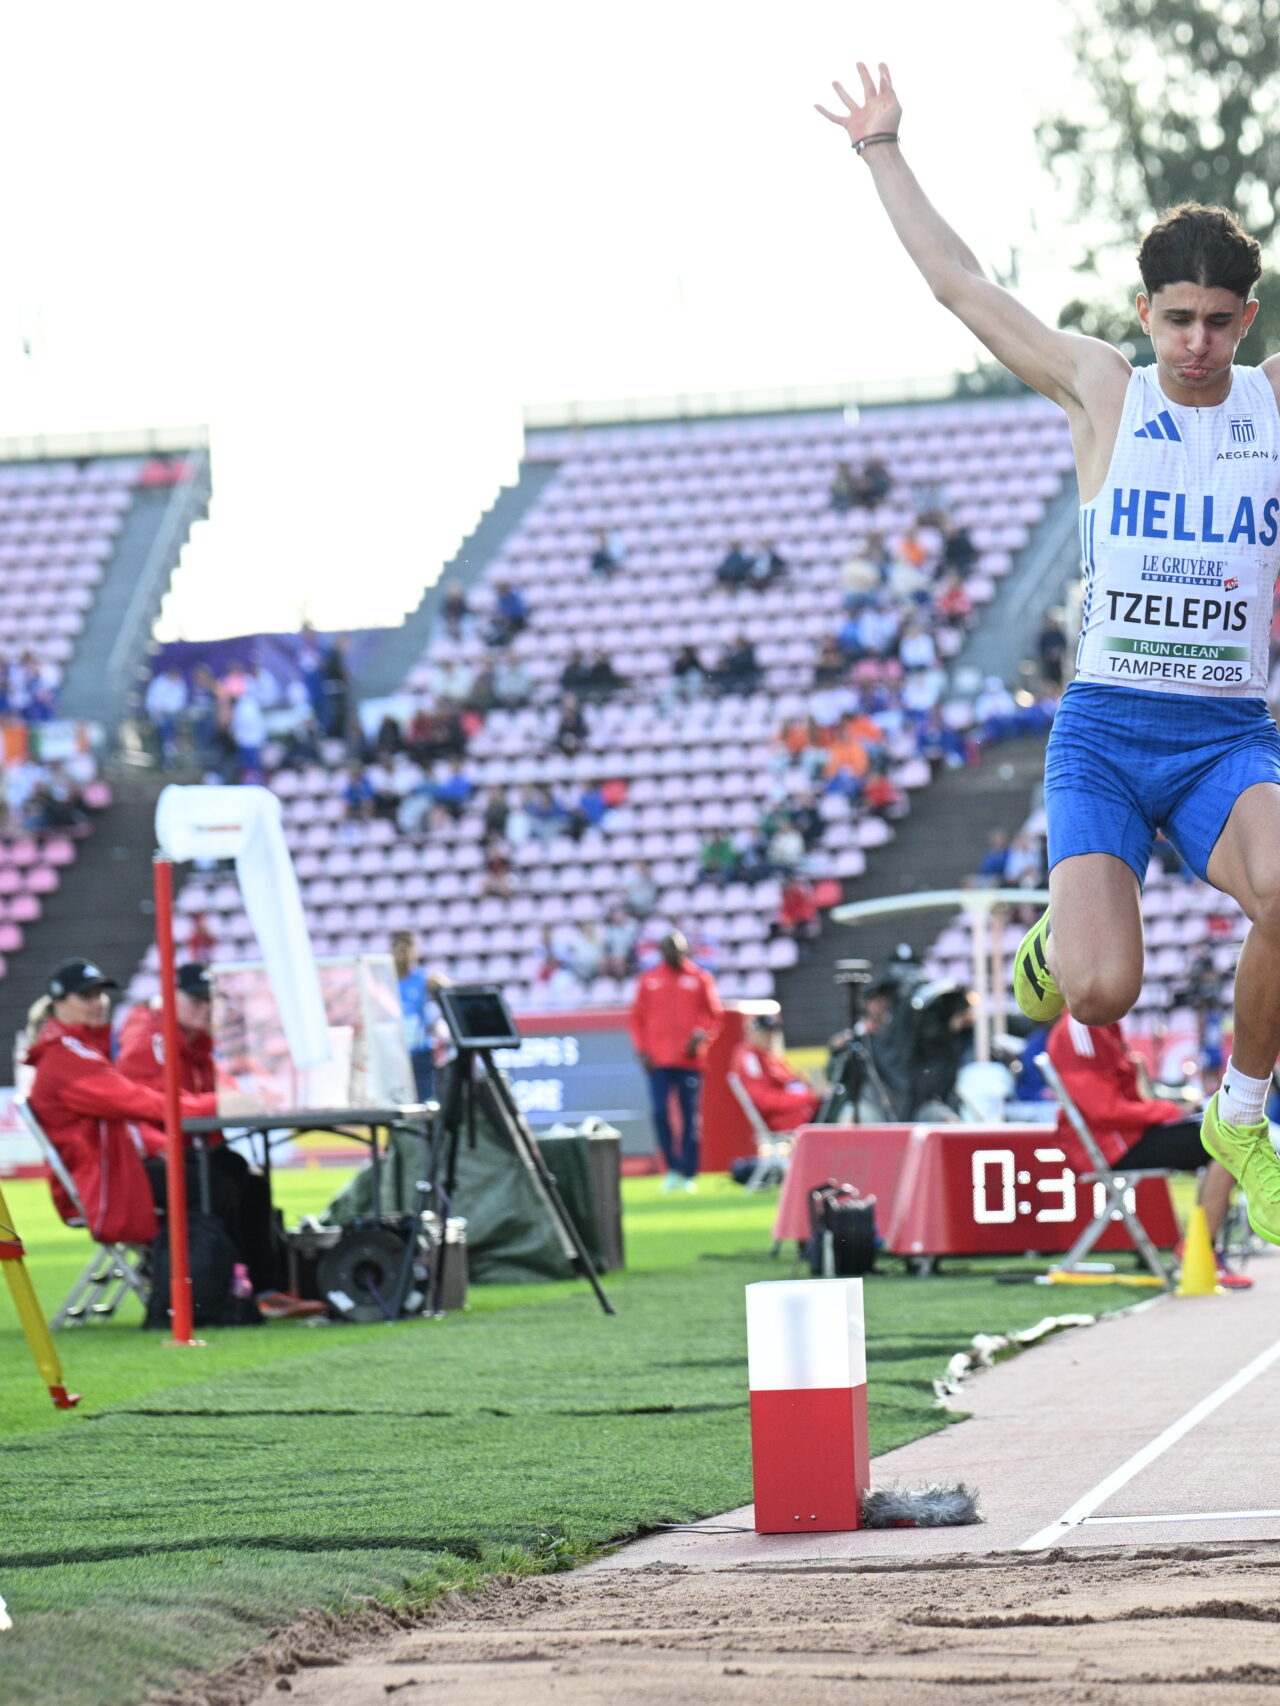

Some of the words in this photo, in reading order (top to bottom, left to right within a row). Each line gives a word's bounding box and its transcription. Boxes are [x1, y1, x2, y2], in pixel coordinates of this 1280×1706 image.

[1216, 451, 1269, 460] AEGEAN
[1110, 488, 1280, 547] HELLAS
[1142, 555, 1159, 571] LE
[1144, 573, 1220, 586] SWITZERLAND
[1106, 590, 1248, 632] TZELEPIS
[1133, 640, 1138, 652] I
[1140, 641, 1170, 655] RUN
[1109, 656, 1198, 680] TAMPERE
[1202, 665, 1243, 682] 2025
